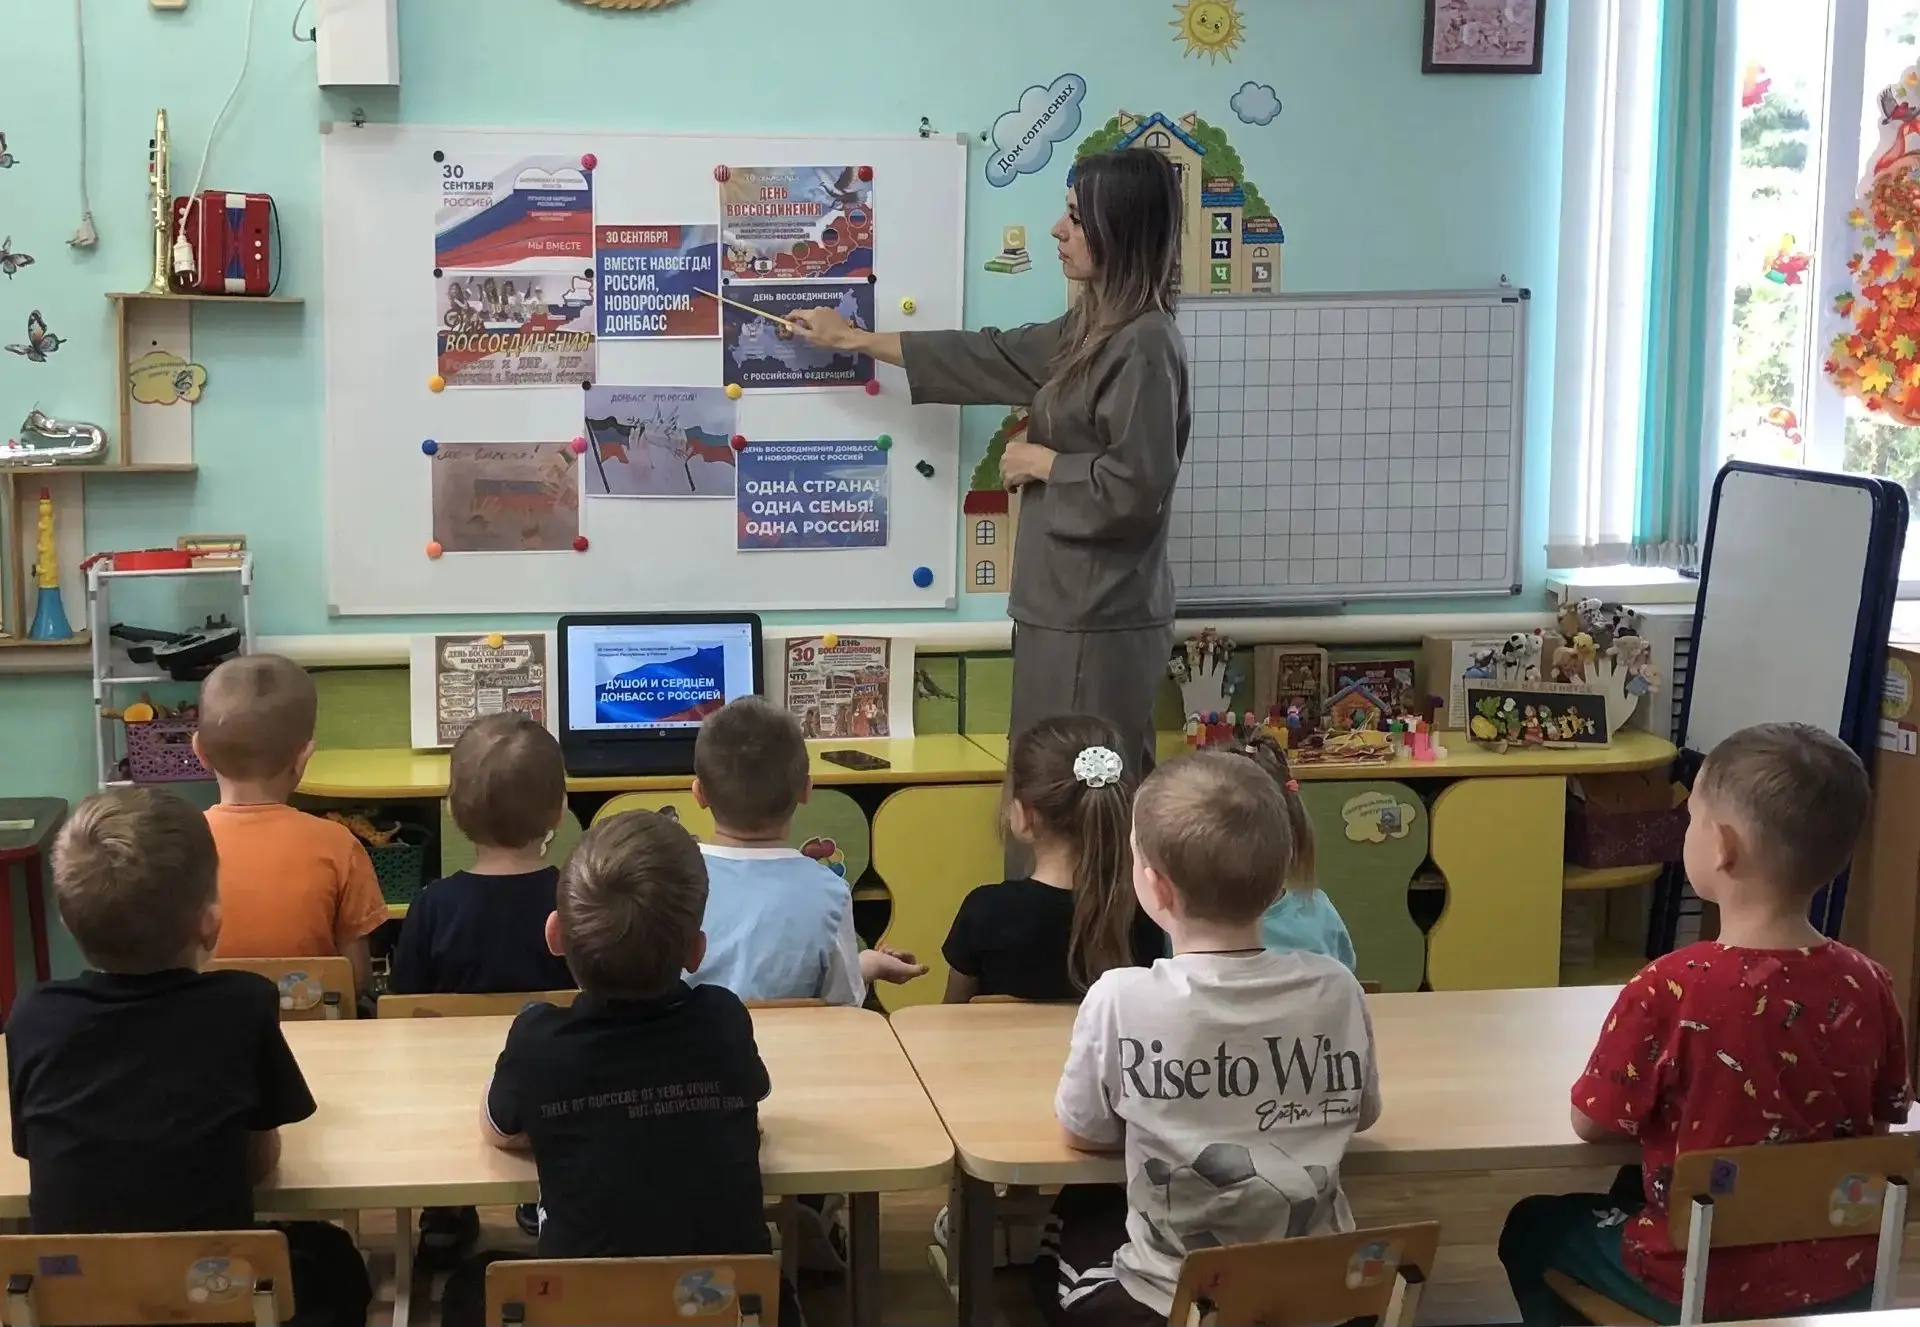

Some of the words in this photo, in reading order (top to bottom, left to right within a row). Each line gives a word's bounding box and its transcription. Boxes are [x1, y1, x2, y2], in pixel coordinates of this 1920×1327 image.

[997, 144, 1023, 173] Дом
[1022, 84, 1075, 145] согласных
[443, 165, 464, 179] 30
[443, 181, 494, 191] СЕНТЯБРЯ
[760, 186, 788, 201] ДЕНЬ
[444, 196, 493, 208] РОССИЕЙ
[726, 203, 822, 217] ВОССОЕДИНЕНИЯ
[1215, 216, 1228, 230] Х
[606, 231, 618, 243] 30
[620, 231, 668, 243] СЕНТЯБРЯ
[527, 241, 544, 250] МЫ
[546, 241, 582, 250] ВМЕСТЕ
[1214, 241, 1228, 256] Ц
[604, 257, 647, 271] ВМЕСТЕ
[650, 256, 711, 272] НАВСЕГДА!
[1215, 267, 1228, 281] Ч
[1255, 266, 1268, 280] Ъ
[604, 274, 659, 292] РОССИЯ,
[604, 295, 694, 312] НОВОРОССИЯ,
[753, 293, 774, 302] ДЕНЬ
[776, 291, 843, 301] ВОССОЕДИНЕНИЯ
[605, 315, 668, 333] ДОНБАСС
[445, 333, 591, 356] ВОССОЕДИНЕНИЯ
[751, 371, 802, 380] РОССИЙСКОЙ
[805, 369, 855, 380] ФЕДЕРАЦИЕЙ
[745, 481, 798, 495] ОДНА
[802, 480, 880, 493] СТРАНА!
[752, 501, 805, 516] ОДНА
[808, 500, 874, 513] СЕМЬЯ!
[745, 521, 798, 536] ОДНА
[803, 520, 880, 533] РОССИЯ!
[792, 647, 814, 661] 30
[606, 677, 648, 690] ДУШОЙ
[651, 679, 658, 688] И
[662, 678, 714, 689] СЕРДЦЕМ
[600, 692, 654, 703] ДОНБАСС
[657, 692, 665, 700] С
[668, 690, 721, 701] РОССИЕЙ
[1118, 1037, 1211, 1099] Rise
[1214, 1041, 1259, 1098] to
[1263, 1034, 1362, 1096] Win
[1256, 1100, 1313, 1132] Extra
